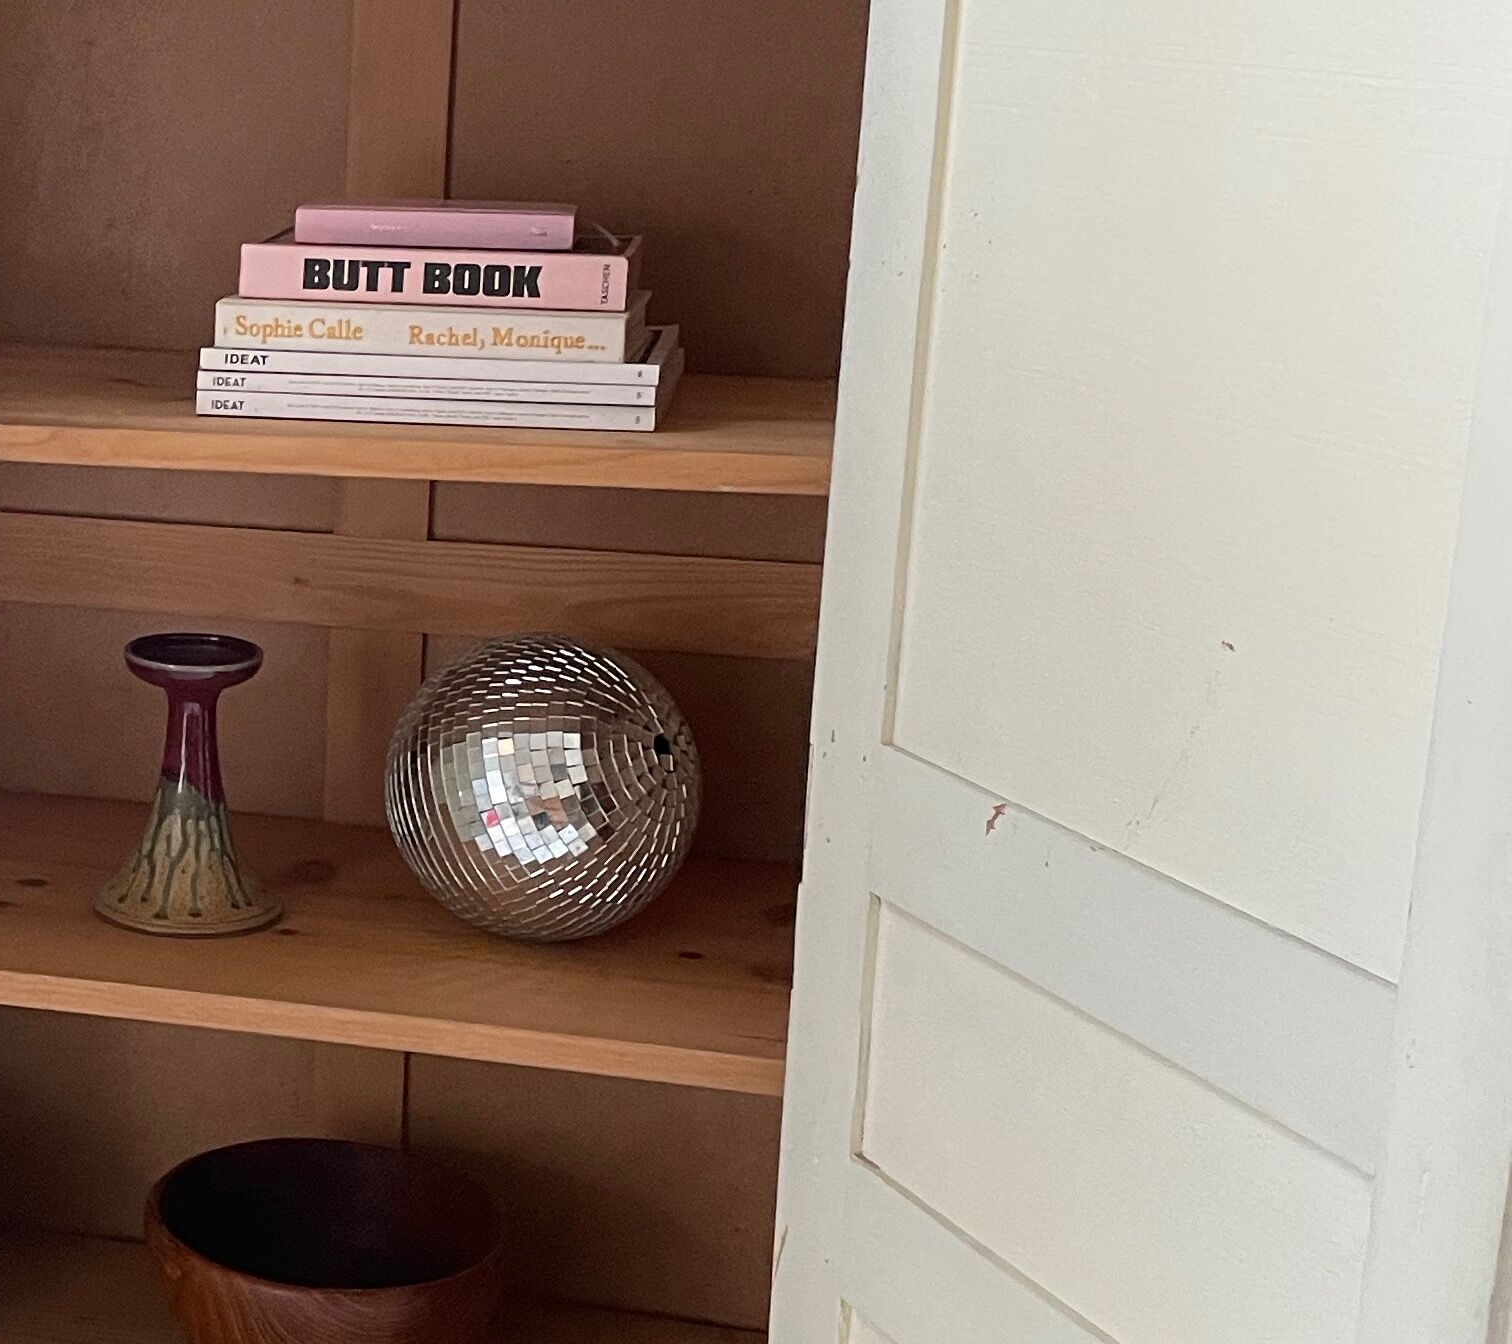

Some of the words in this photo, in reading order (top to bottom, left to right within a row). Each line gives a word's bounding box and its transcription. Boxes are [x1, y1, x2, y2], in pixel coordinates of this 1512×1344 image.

[302, 258, 412, 293] BUTT
[422, 262, 543, 299] BOOK
[599, 263, 611, 306] TASCHEN
[235, 315, 304, 344] Sophie
[308, 317, 364, 340] Calle
[408, 324, 486, 350] Rachel,
[224, 353, 270, 365] IDEAT
[212, 376, 247, 387] IDEAT
[211, 399, 245, 410] IDEAT
